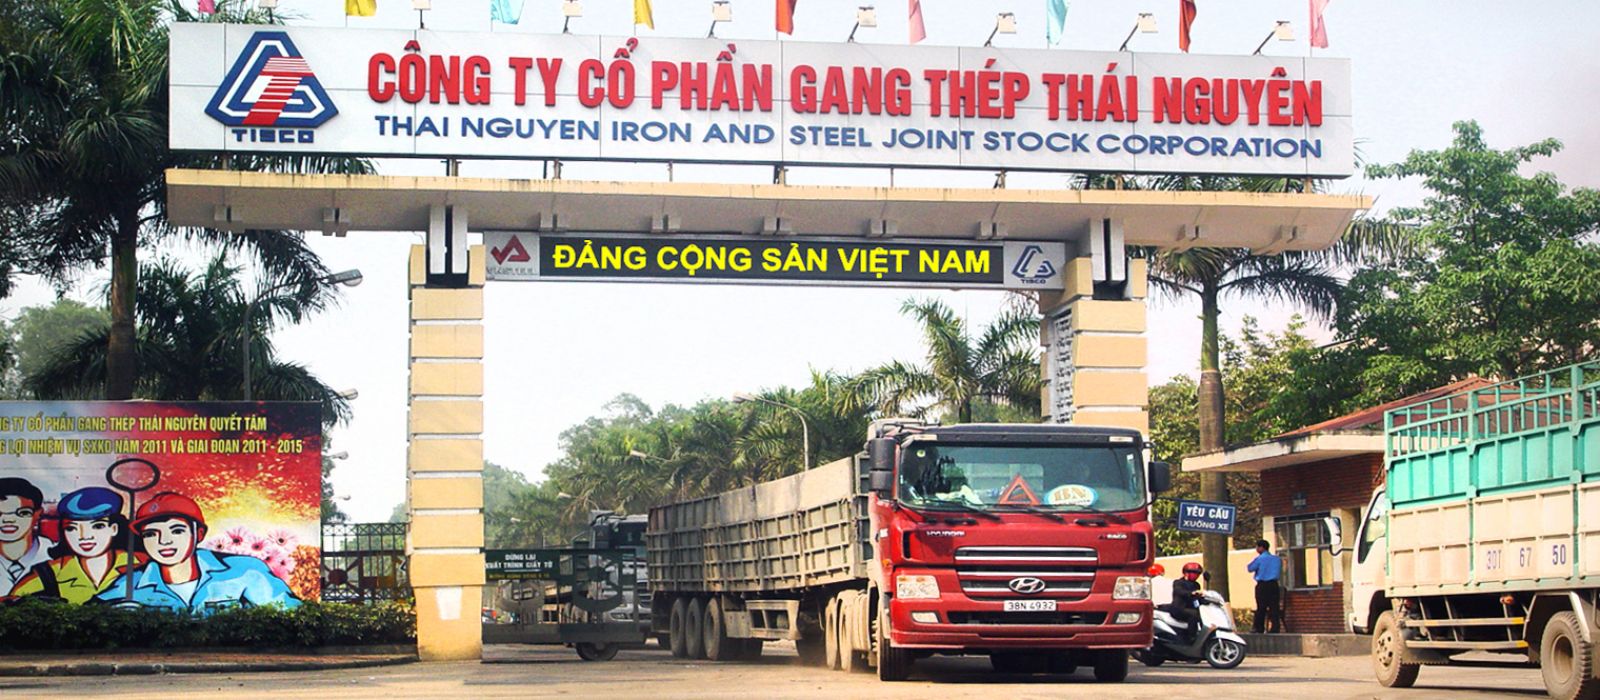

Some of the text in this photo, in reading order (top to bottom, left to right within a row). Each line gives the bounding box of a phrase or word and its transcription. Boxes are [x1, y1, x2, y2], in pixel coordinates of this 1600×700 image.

[368, 38, 1322, 126] CÔNG TY CỔ PHẦN GANG THÉP THÁI NGUYÊN
[232, 128, 314, 143] TISCO
[374, 115, 1322, 158] THAI NGUYEN IRON AND STEEL JOINT STOCK CORPORATION
[553, 240, 990, 278] ĐẢNG CỘNG SẢN VIỆT NAM
[12, 416, 25, 432] TY
[77, 416, 107, 432] GANG
[109, 412, 136, 432] THÉP
[139, 414, 162, 431] THÁI
[165, 414, 207, 431] NGUYÊN
[209, 412, 243, 432] QUYẾT
[244, 414, 267, 431] TÂM
[66, 439, 81, 457] VỤ
[115, 436, 139, 454] NĂM
[143, 440, 167, 453] 2011
[170, 437, 184, 453] VÀ
[187, 440, 208, 453] GIAI
[211, 440, 239, 456] ĐOẠN
[242, 440, 266, 453] 2011
[277, 440, 302, 453] 2015
[1186, 506, 1229, 519] YÊU CẦU
[1519, 547, 1532, 567] 67
[1552, 544, 1567, 565] 50
